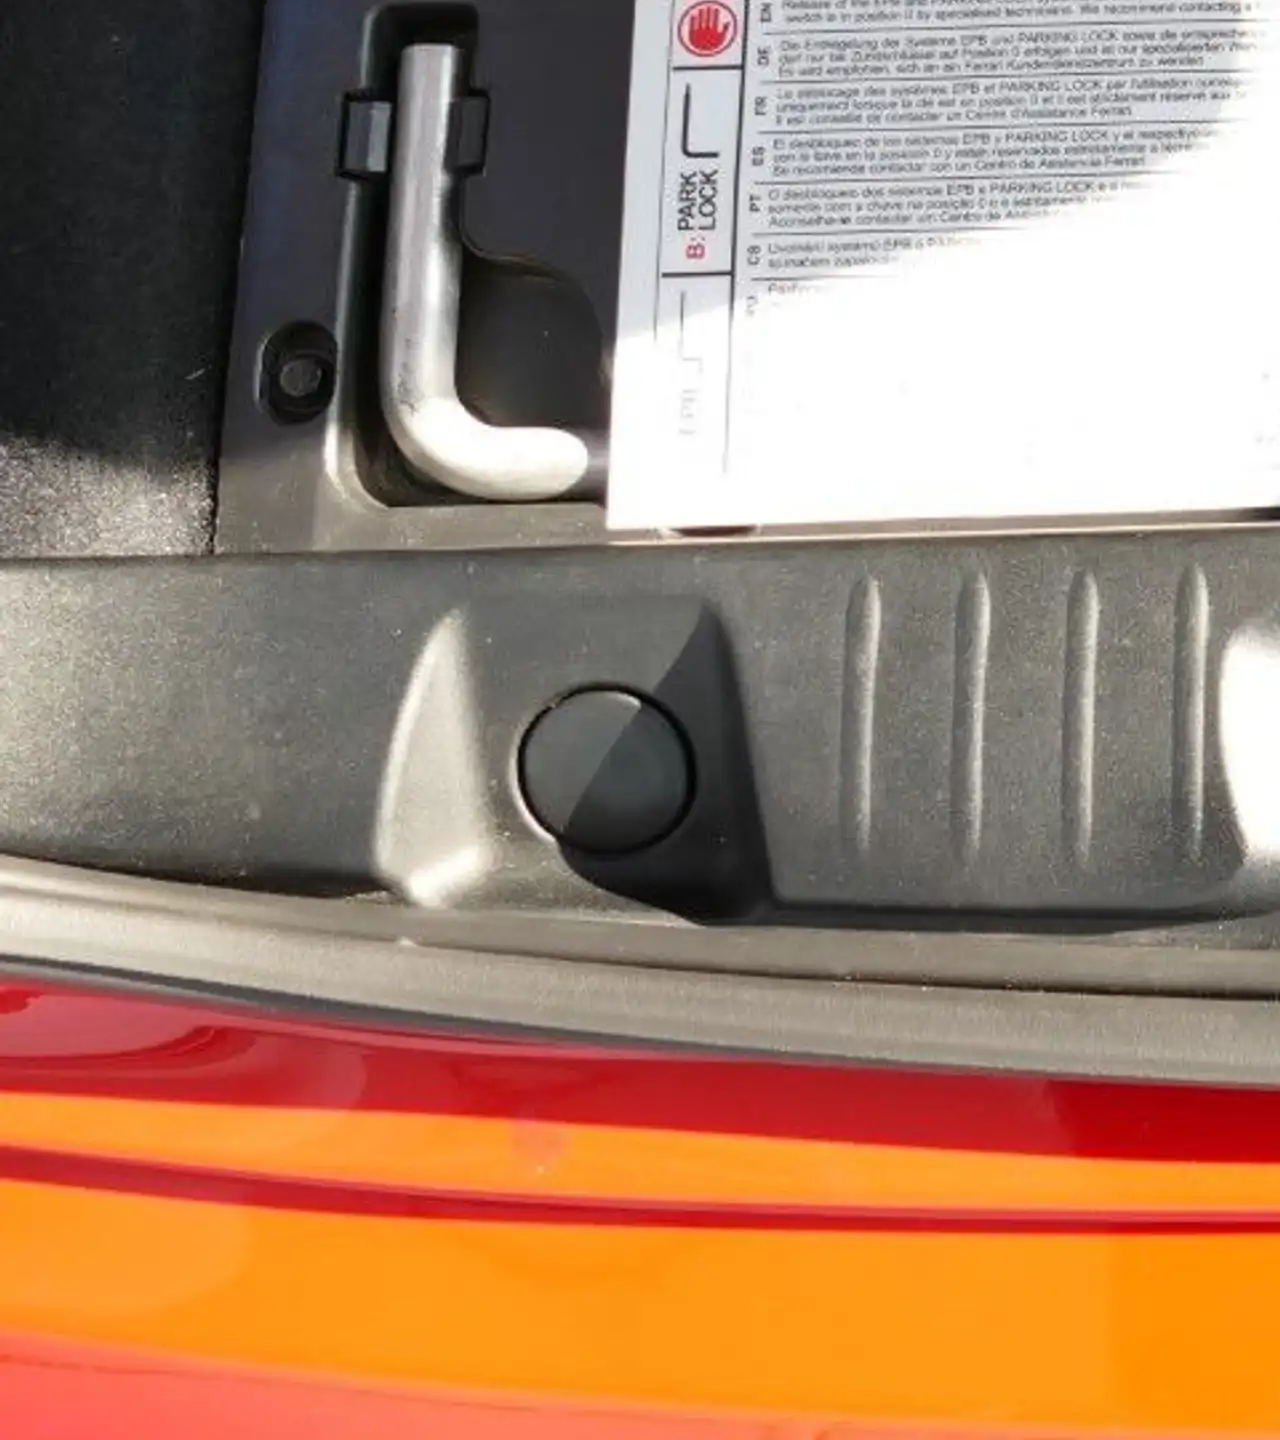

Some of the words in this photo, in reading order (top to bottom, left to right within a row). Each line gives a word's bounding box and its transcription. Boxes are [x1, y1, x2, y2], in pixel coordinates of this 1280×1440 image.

[761, 2, 772, 23] EN
[758, 46, 769, 67] DE
[755, 95, 766, 116] FR
[676, 171, 697, 231] PARK
[699, 169, 718, 231] LOCK
[749, 193, 761, 213] PT
[685, 237, 706, 260] B:
